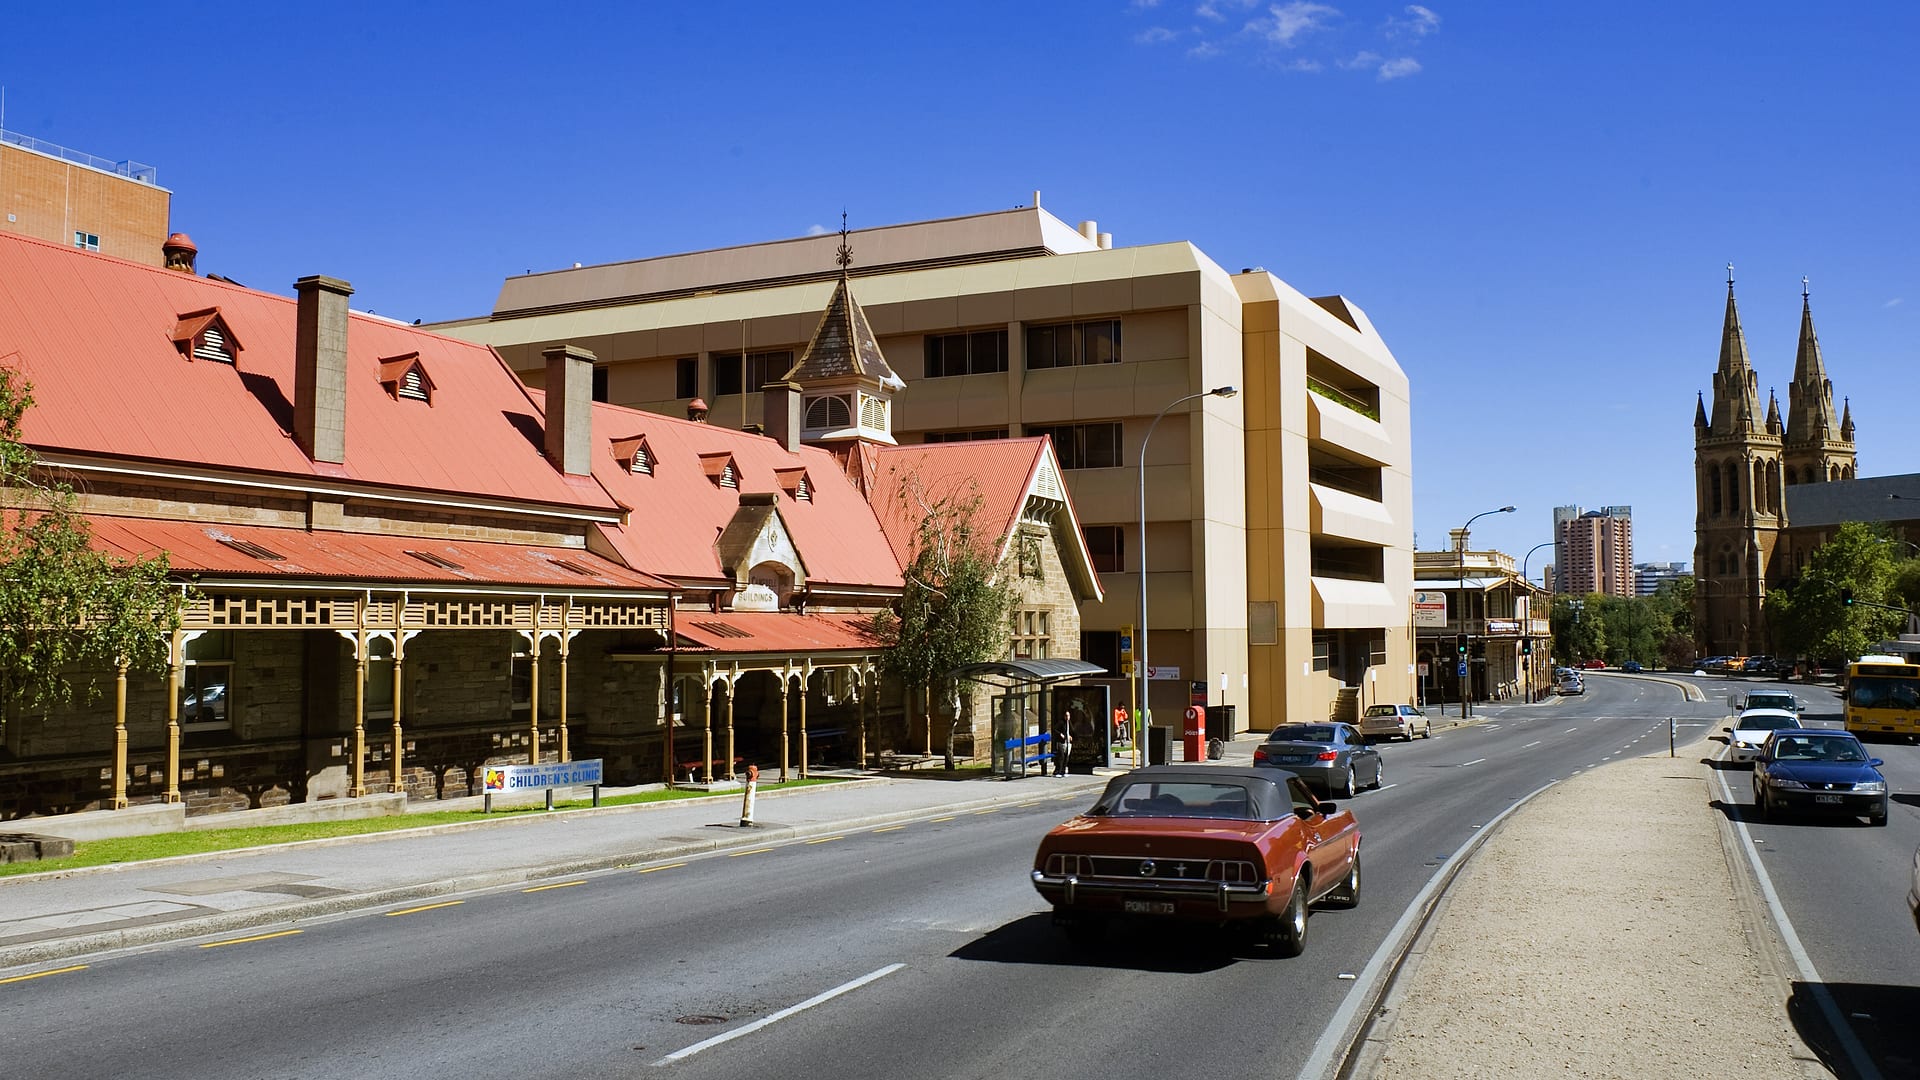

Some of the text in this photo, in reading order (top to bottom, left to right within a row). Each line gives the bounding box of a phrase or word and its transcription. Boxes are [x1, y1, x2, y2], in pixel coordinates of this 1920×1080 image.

[738, 592, 773, 602] BUILDINGS
[509, 769, 600, 788] CHILDREN'S CLINIC
